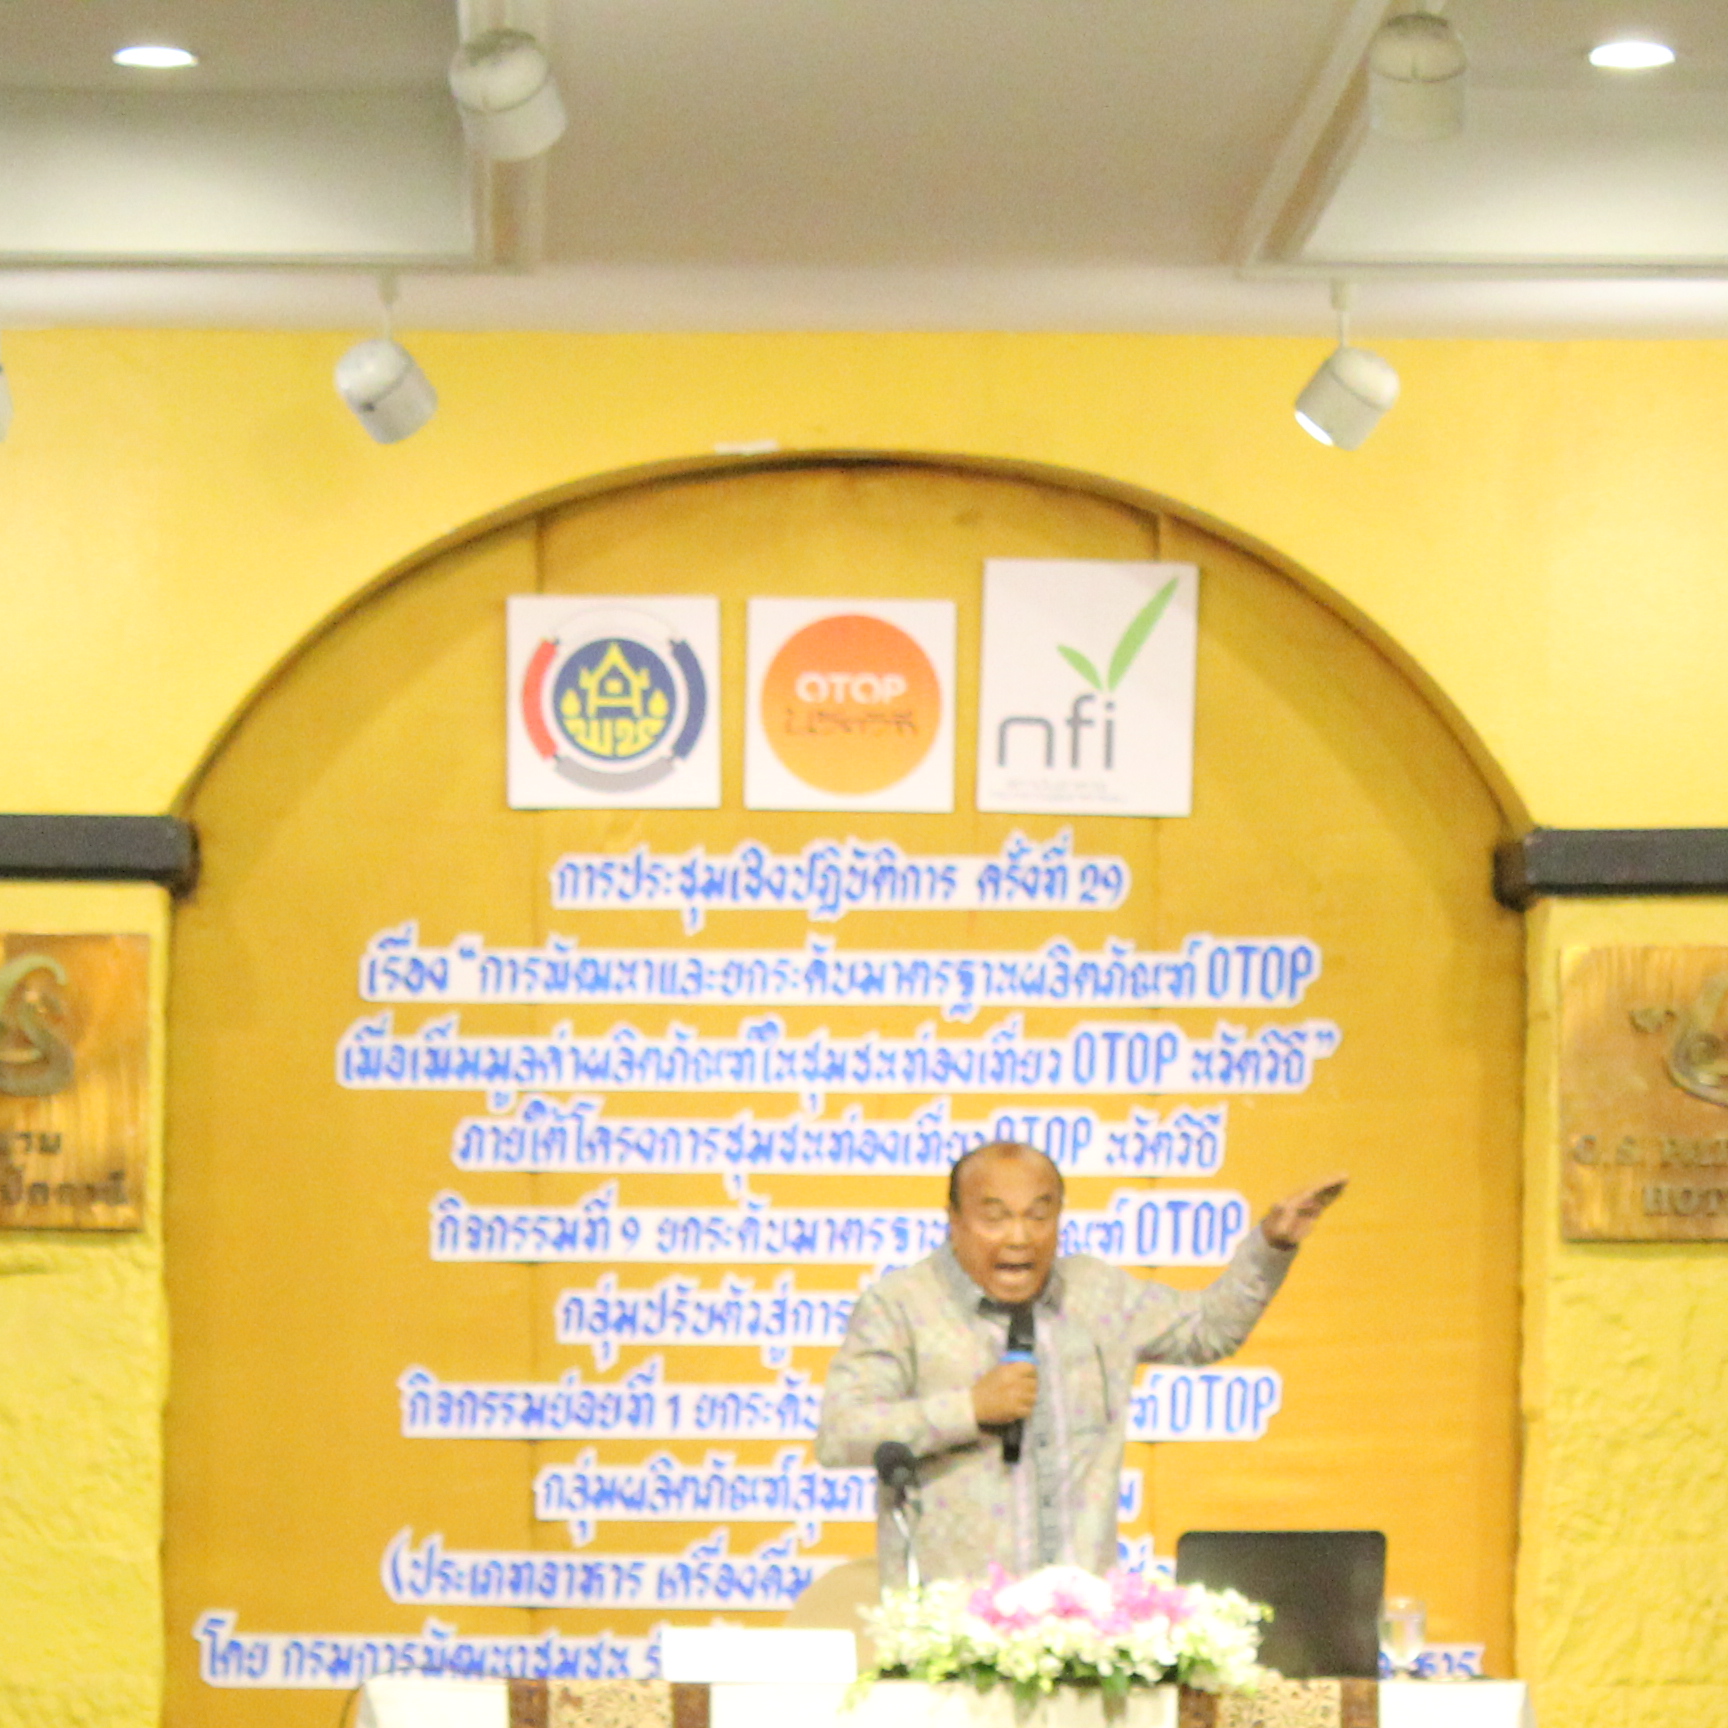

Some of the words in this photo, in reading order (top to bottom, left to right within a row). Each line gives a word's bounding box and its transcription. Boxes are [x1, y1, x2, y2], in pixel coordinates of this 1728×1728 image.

[796, 671, 908, 704] OTOP
[996, 690, 1116, 770] nfi
[558, 845, 959, 922] การประชุมเชิงปฏิบัติการ
[978, 836, 1071, 903] ครั้งที่
[368, 925, 450, 995] เรื่อง
[1208, 944, 1315, 1001] OTOP
[1072, 1030, 1179, 1087] OTOP
[1106, 1111, 1222, 1170] นวัตวิถี
[439, 1189, 612, 1253] กิจกรรมที่
[1136, 1199, 1245, 1258] OTOP
[407, 1362, 657, 1432] กิจกรรมย่อยที่
[1170, 1374, 1278, 1435] OTOP
[203, 1617, 270, 1679] โดย
[284, 1627, 633, 1680] กรมการพัฒนาชมชน
